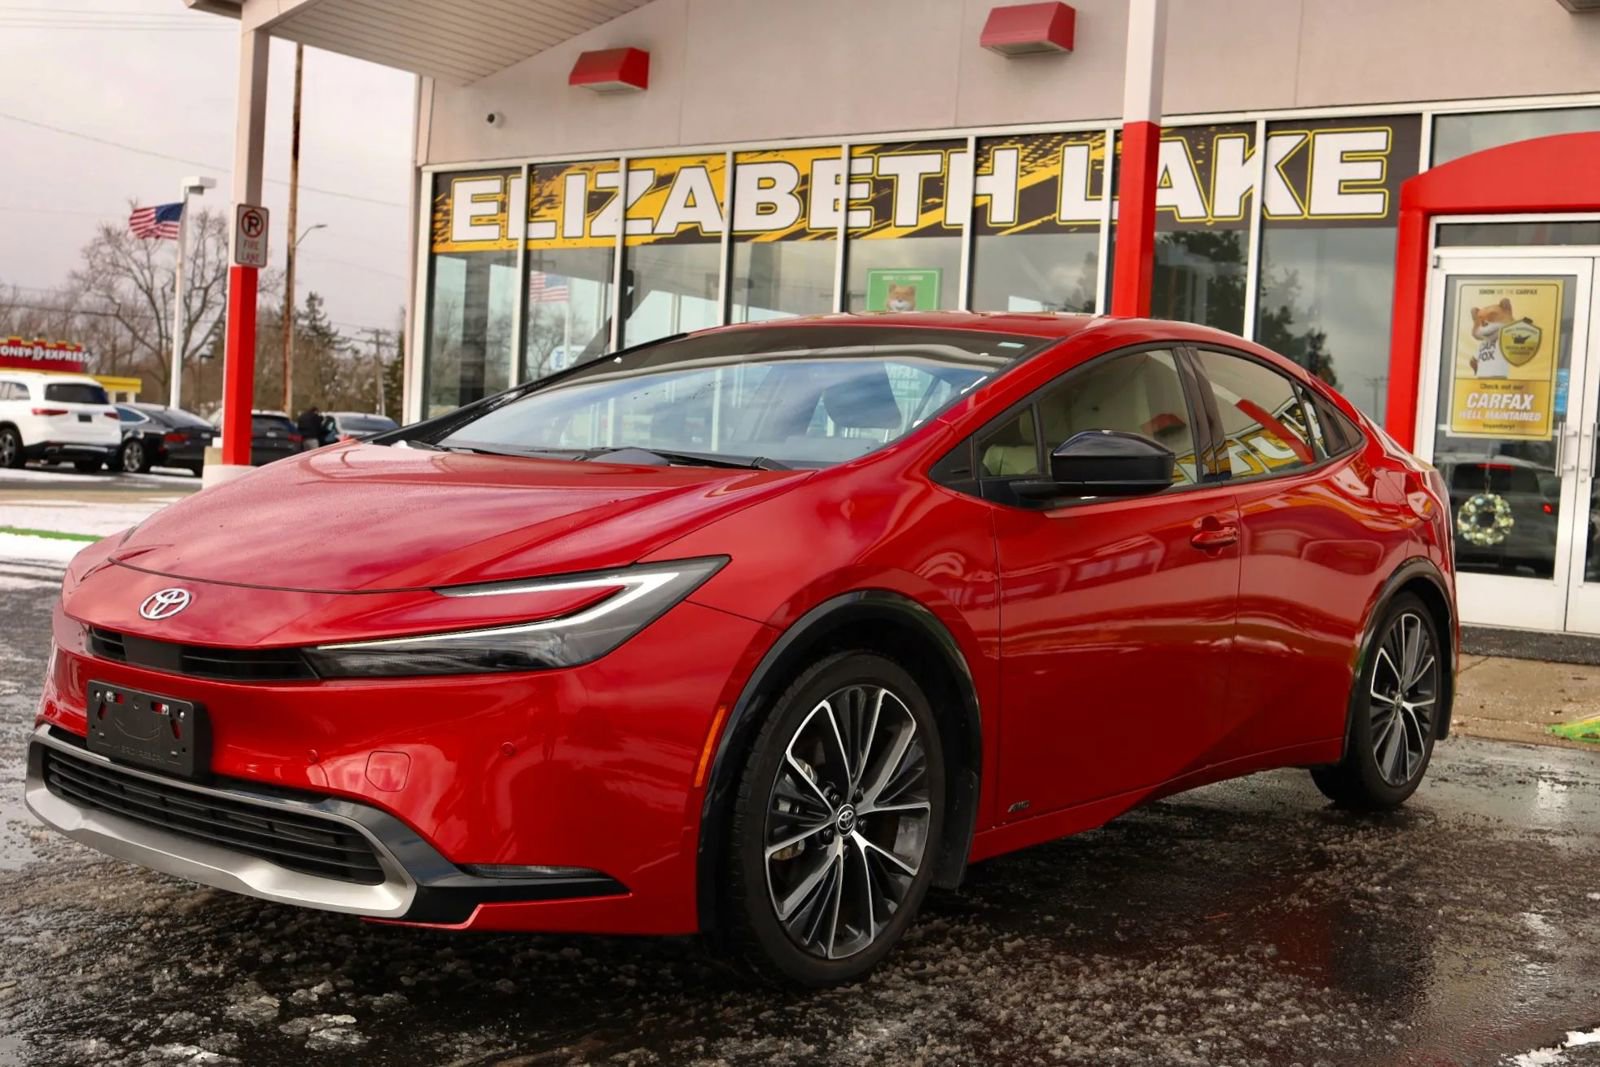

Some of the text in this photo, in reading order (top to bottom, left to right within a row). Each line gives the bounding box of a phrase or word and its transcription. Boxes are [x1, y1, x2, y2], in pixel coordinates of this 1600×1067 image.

[450, 127, 1391, 242] ELIZABETH LAKE
[0, 345, 91, 362] ONEY EXPRESS
[1467, 392, 1534, 410] CARFAX
